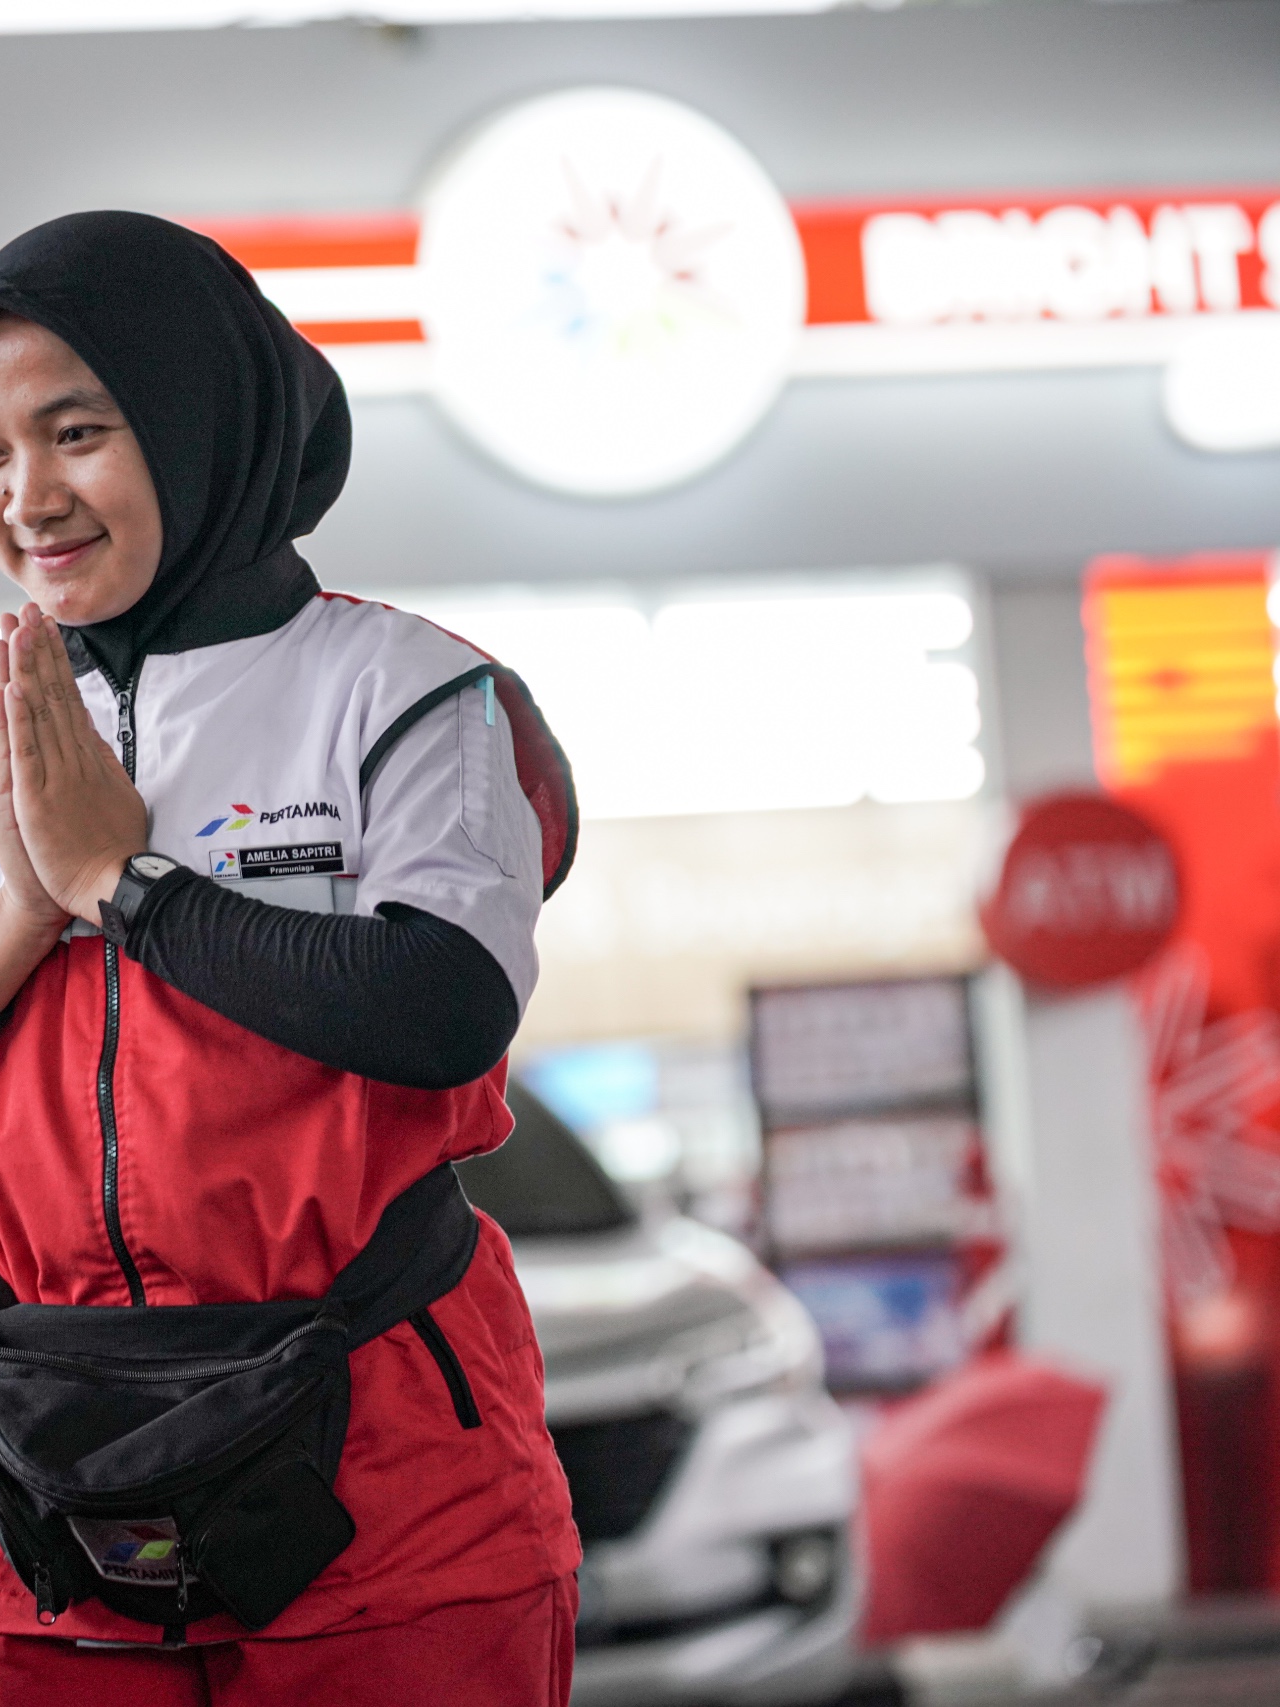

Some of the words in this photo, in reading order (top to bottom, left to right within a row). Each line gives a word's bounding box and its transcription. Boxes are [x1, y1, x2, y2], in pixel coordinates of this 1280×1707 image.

[259, 802, 342, 824] PERTAMINA
[245, 850, 289, 863] AMELIA
[291, 845, 336, 859] SAPITRI
[269, 864, 315, 875] Pramuniaga
